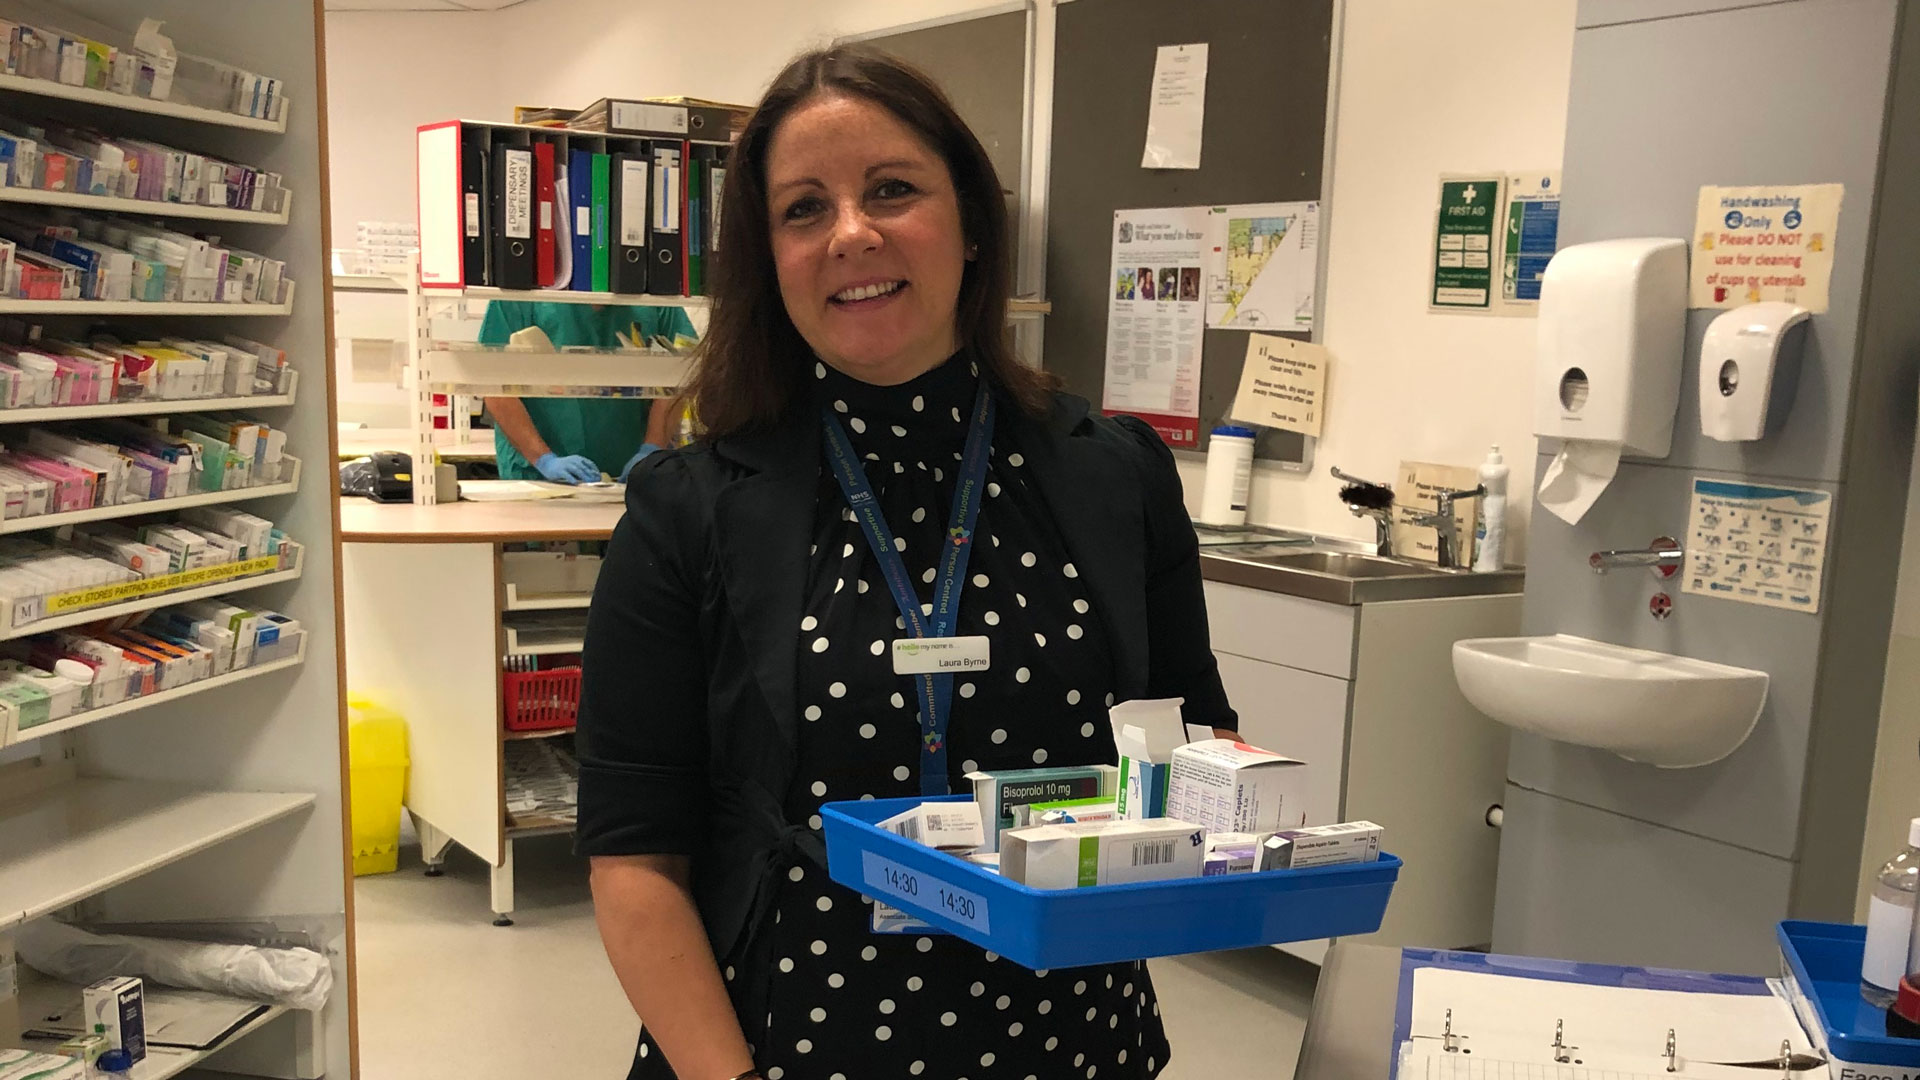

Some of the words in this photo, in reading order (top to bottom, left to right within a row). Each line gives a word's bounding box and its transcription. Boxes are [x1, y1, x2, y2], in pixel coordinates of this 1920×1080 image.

[508, 160, 518, 224] DISPENSARY
[519, 166, 528, 218] MEETINGS
[1720, 195, 1801, 210] Handwashing
[1448, 206, 1470, 216] FIRST
[1472, 206, 1486, 216] AID
[1744, 216, 1772, 230] Only
[1136, 230, 1150, 240] What
[1150, 232, 1162, 244] you
[1164, 229, 1177, 240] need
[1186, 228, 1204, 240] know
[1720, 233, 1754, 246] Please
[1757, 234, 1775, 246] DO
[1778, 234, 1802, 246] NOT
[1715, 256, 1733, 265] use
[1736, 254, 1752, 265] for
[1755, 254, 1802, 269] cleaning
[1706, 272, 1720, 284] of
[1720, 276, 1744, 287] cups
[1762, 275, 1806, 286] utensils
[1268, 355, 1284, 363] Please
[1254, 379, 1272, 387] Please
[1272, 412, 1287, 420] Thank
[1416, 482, 1431, 491] Please
[850, 491, 870, 500] NHS
[958, 480, 974, 524] Supportive
[864, 507, 888, 552] Supportive
[1416, 542, 1432, 550] Thank
[947, 546, 960, 576] Person
[58, 596, 82, 608] CHECK
[85, 590, 113, 602] STORES
[115, 582, 150, 596] PARTPACK
[151, 576, 180, 590] SHELVES
[182, 570, 205, 583] BEFORE
[208, 566, 234, 578] OPENING
[240, 562, 253, 572] NEW
[255, 560, 269, 569] PACK
[940, 578, 953, 614] Centred
[22, 604, 31, 618] M
[939, 659, 961, 667] Laura
[964, 658, 986, 667] Byrne
[924, 674, 936, 727] Committed
[1003, 785, 1044, 799] Bisoprolol
[1046, 783, 1056, 795] 10
[1058, 785, 1071, 796] mg
[1120, 788, 1126, 802] mg
[1119, 802, 1124, 812] 15
[1235, 784, 1243, 816] Caplets
[884, 866, 918, 896] 14:30
[940, 888, 975, 920] 14:30
